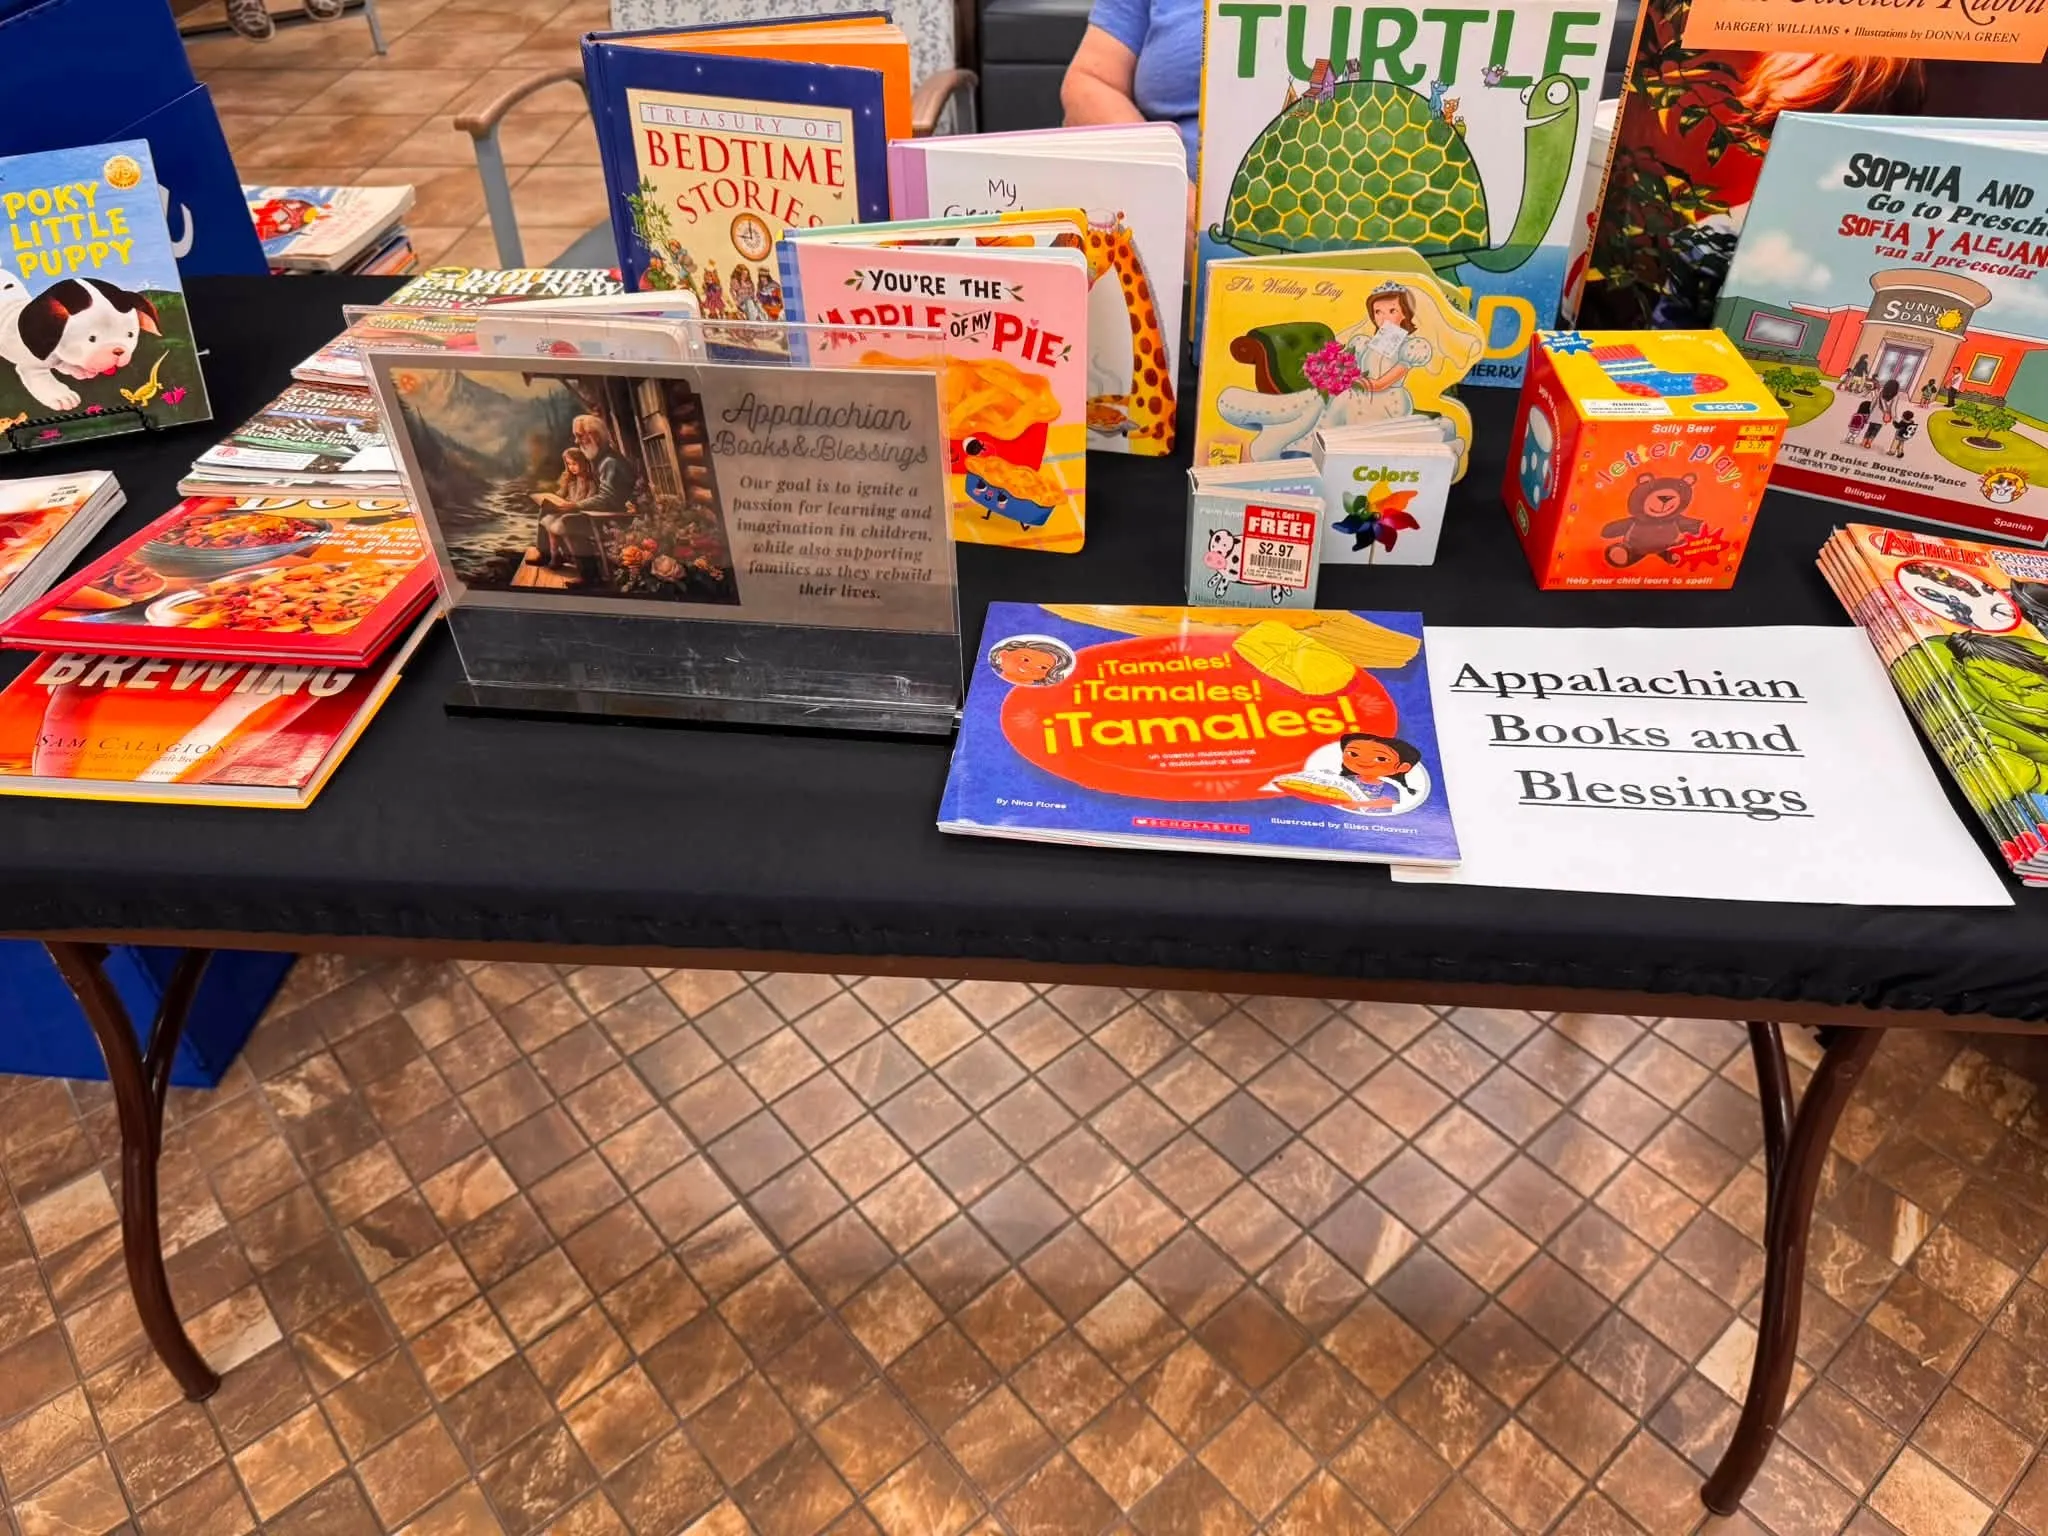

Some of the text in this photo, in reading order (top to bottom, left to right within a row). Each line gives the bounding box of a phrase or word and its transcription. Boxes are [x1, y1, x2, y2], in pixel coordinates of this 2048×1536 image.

[1714, 21, 2020, 43] MARGERY WILLIAMS Illustrations by DONNA GREEN
[1218, 4, 1601, 90] TURTLE
[647, 105, 836, 138] TREASURY OF
[644, 129, 846, 188] BEDTIME
[988, 179, 1018, 207] My
[1843, 152, 2035, 210] SOPHIA AND
[2, 181, 99, 219] POKY
[676, 177, 824, 229] STORIES
[1867, 193, 1906, 214] Go
[1912, 201, 1943, 220] to
[10, 208, 132, 251] LITTLE
[1838, 213, 1911, 246] SOFÍA
[1925, 226, 1945, 250] Y
[16, 238, 134, 279] PUPPY
[1873, 244, 2039, 281] van al pre-escolar
[462, 268, 612, 285] MOTHER
[869, 269, 1002, 300] YOU'RE THE
[1225, 275, 1344, 302] The Wedding Day
[1900, 311, 1935, 324] DAY
[949, 319, 970, 339] OF
[971, 310, 992, 332] MY
[992, 311, 1065, 368] PIE
[272, 402, 327, 415] Farm
[292, 388, 358, 402] Create
[1704, 403, 1747, 411] SOCK
[721, 392, 912, 434] Appalachian
[1651, 423, 1716, 435] Sally Beer
[1352, 465, 1420, 482] Colors
[1596, 440, 1743, 483] letter play
[1813, 447, 1827, 459] BY
[1830, 453, 1869, 468] Denise
[1871, 461, 1968, 488] Bourgeois-Vance
[740, 476, 919, 498] Our goal is to ignite a
[1839, 465, 1851, 475] BY
[1853, 469, 1887, 482] Damon
[1888, 474, 1935, 492] Danielson
[1843, 485, 1887, 502] Bilingual
[733, 498, 933, 520] passion for learning and
[1261, 508, 1276, 519] Buy
[1282, 511, 1296, 520] Get
[737, 519, 834, 538] imagination
[839, 522, 856, 537] in
[1247, 516, 1311, 539] FREE!
[1993, 516, 2035, 533] Spanish
[753, 541, 923, 564] while also supporting
[1258, 542, 1294, 558] $2.97
[1880, 529, 1990, 568] AVENGERS
[748, 560, 932, 582] families as they rebuild
[1566, 577, 1713, 586] Help your child learn to spell!
[799, 581, 881, 599] their lives.
[34, 652, 356, 698] BREWING
[1097, 652, 1233, 679] ¡Tamales!
[1073, 679, 1264, 705] ¡Tamales!
[1449, 662, 1806, 701] Appalachian
[1043, 695, 1362, 756] ¡Tamales!
[1485, 713, 1803, 753] Books and
[38, 734, 239, 756] SAM CALAGION
[996, 797, 1067, 810] By Nina Flores
[1514, 769, 1810, 821] Blessings
[1150, 819, 1249, 834] SCHOLASTIC
[1270, 817, 1325, 828] Illustrated
[1328, 820, 1341, 830] by
[1344, 822, 1370, 831] Elisa
